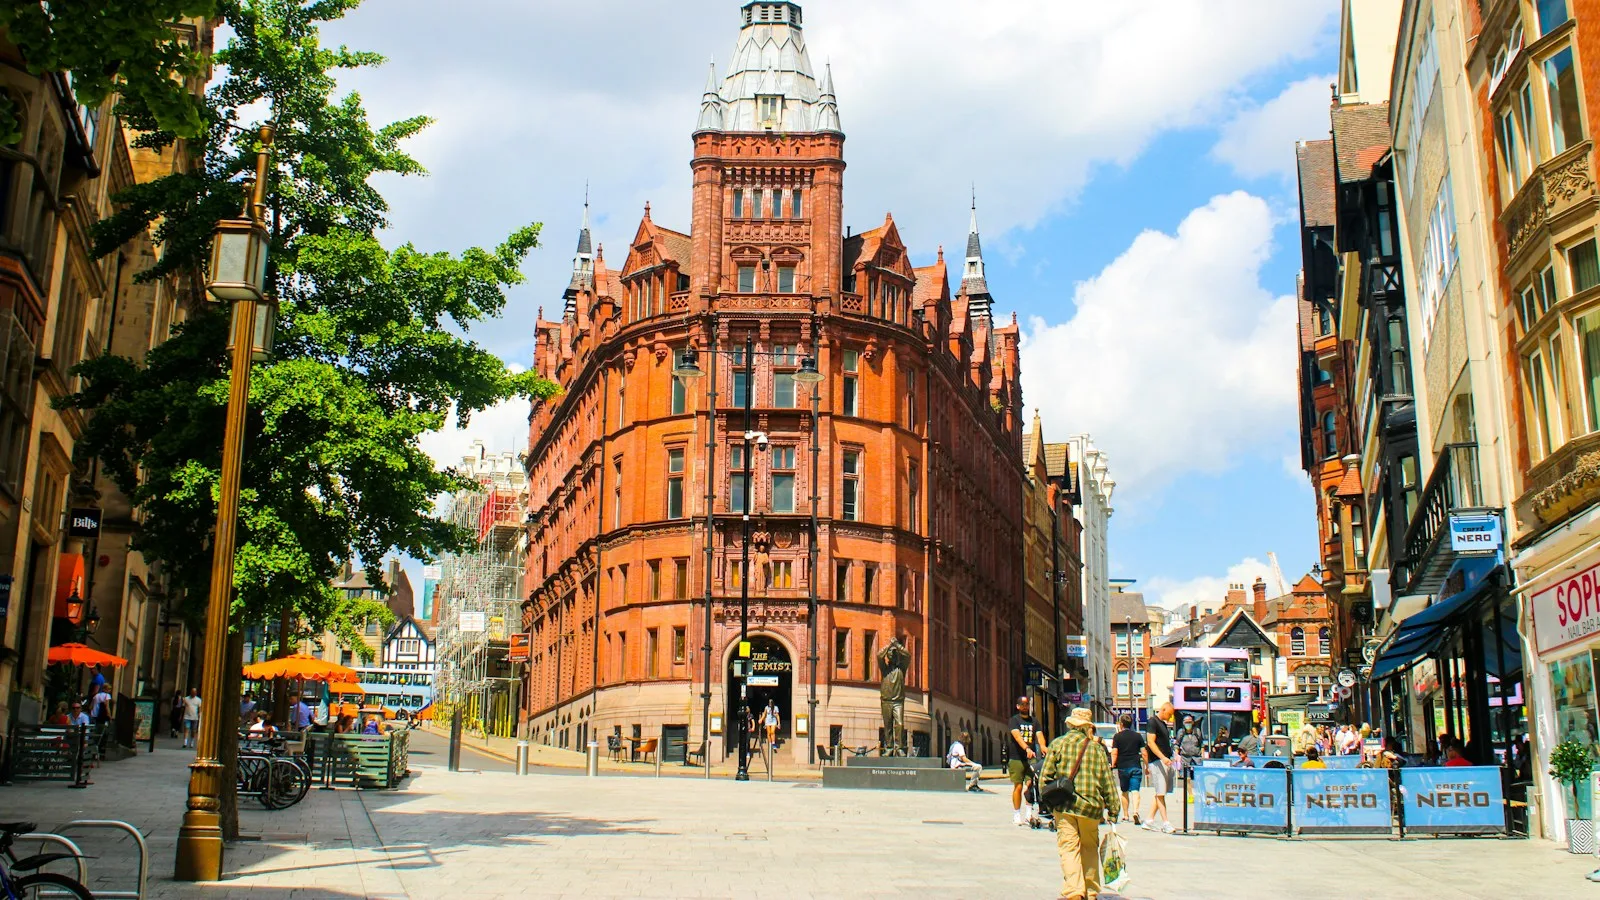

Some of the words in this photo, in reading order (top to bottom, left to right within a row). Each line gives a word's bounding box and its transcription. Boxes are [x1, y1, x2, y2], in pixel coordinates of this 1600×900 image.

[73, 517, 97, 529] Bill's
[1457, 534, 1491, 542] NERO
[1567, 625, 1582, 639] NAIL
[1582, 618, 1595, 635] BAR
[1226, 689, 1235, 698] 27
[1206, 792, 1274, 808] NERO
[1306, 793, 1377, 809] NERO
[1416, 792, 1490, 808] NERO
